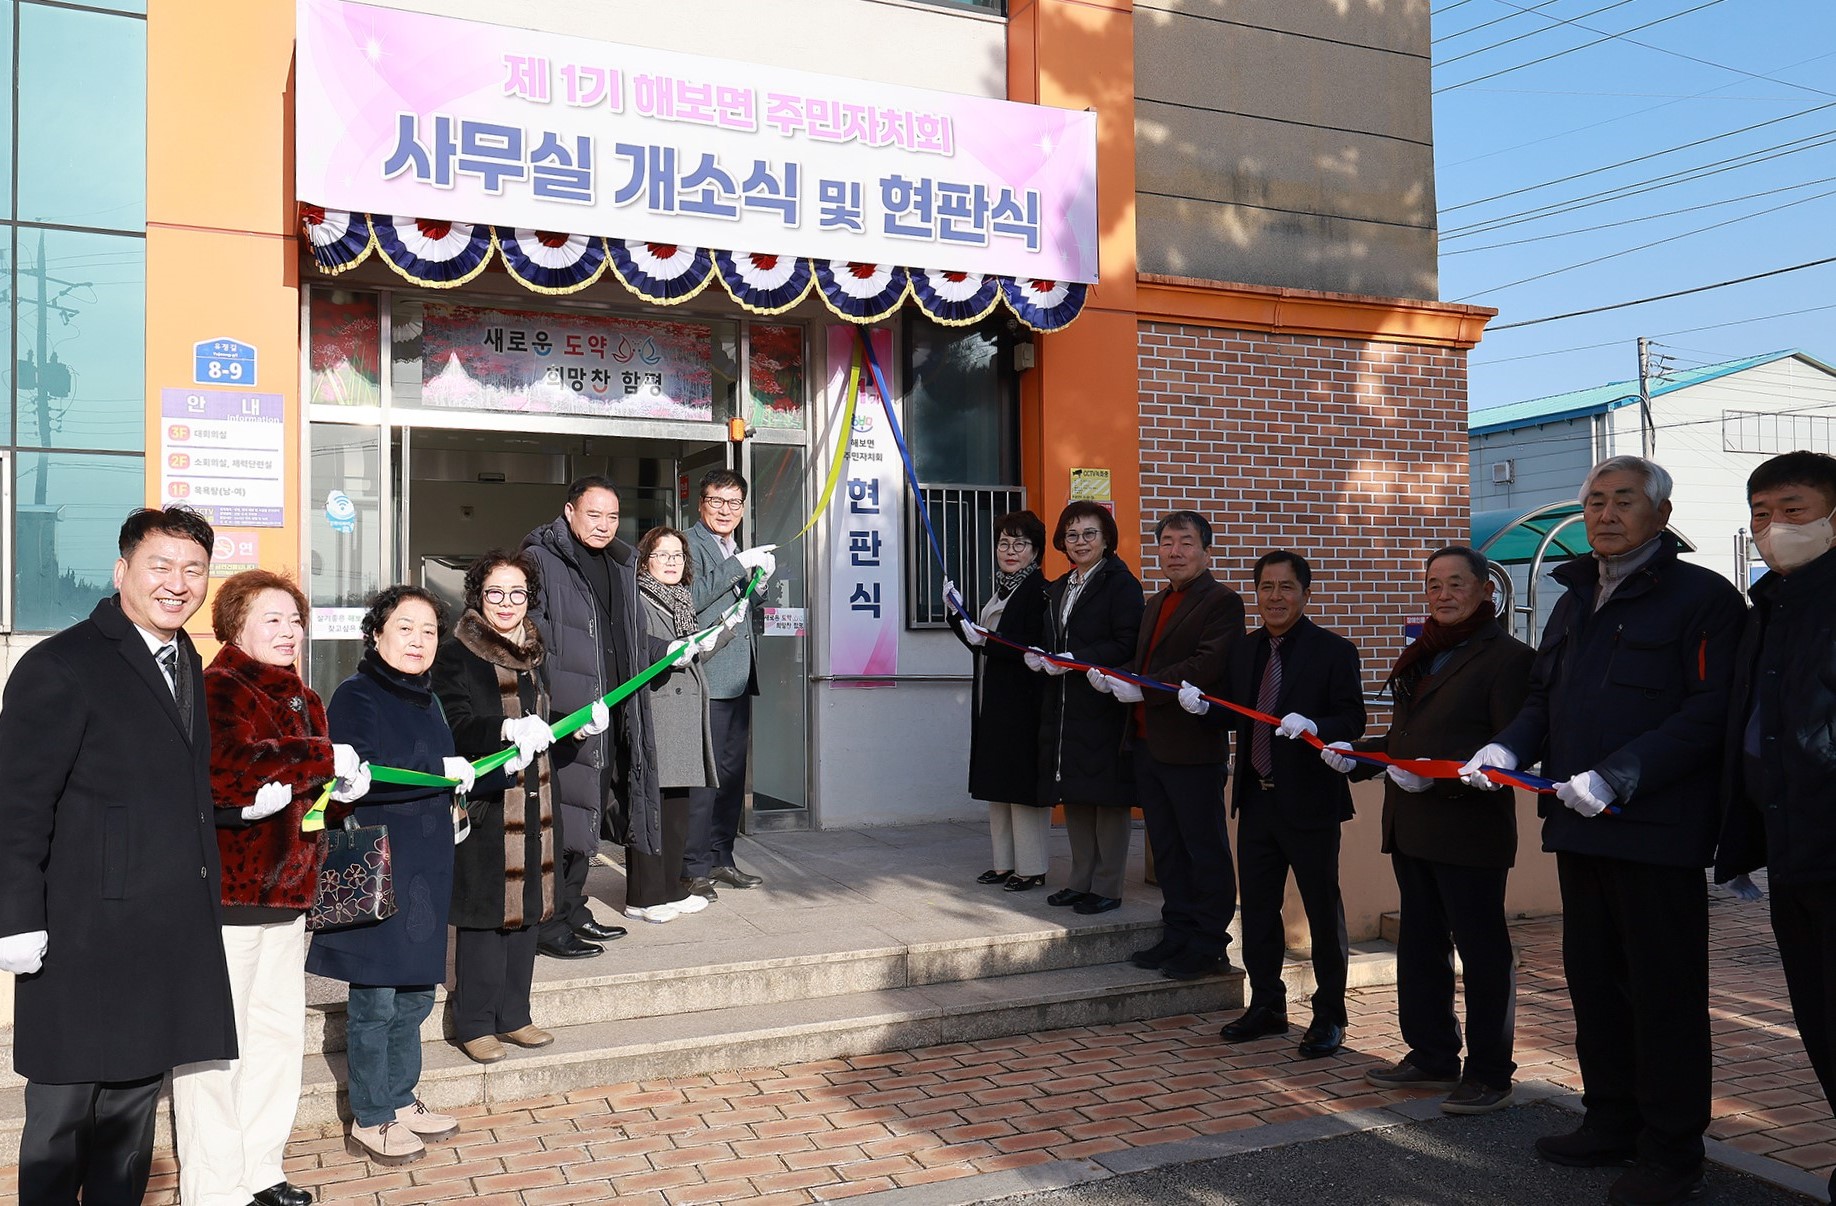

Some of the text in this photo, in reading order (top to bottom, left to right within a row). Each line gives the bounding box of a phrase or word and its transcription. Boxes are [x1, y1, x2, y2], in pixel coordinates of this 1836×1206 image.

[504, 54, 951, 152] 제 1기 해보면 주민자치회
[384, 114, 1038, 249] 사무실 개소식 및 현판식
[483, 328, 608, 360] 새로운 도약
[208, 361, 243, 380] 8-9
[546, 364, 662, 396] 희망찬 함평
[171, 427, 188, 438] 3F
[851, 438, 875, 449] 해보면
[171, 455, 188, 467] 2F
[843, 451, 883, 462] 주민자치회
[171, 484, 188, 495] 1F
[847, 478, 882, 619] 현판식
